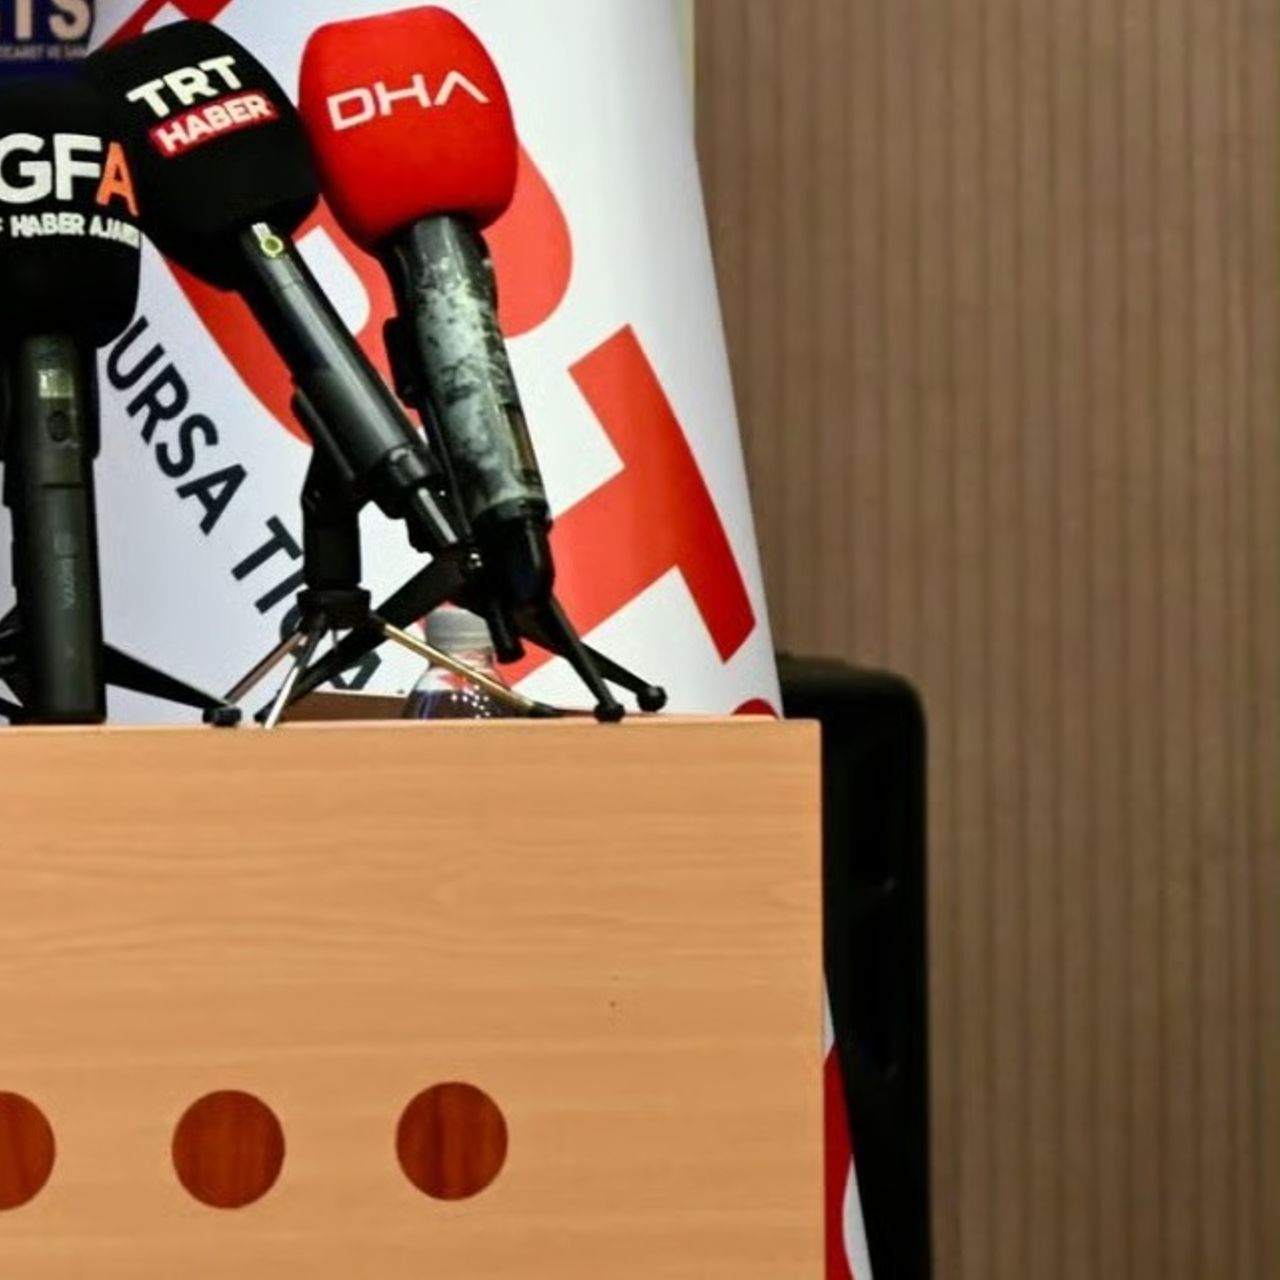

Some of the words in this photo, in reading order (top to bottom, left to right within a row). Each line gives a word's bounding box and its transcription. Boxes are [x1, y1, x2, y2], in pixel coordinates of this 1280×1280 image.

[126, 54, 243, 119] TRT
[326, 69, 490, 132] DHA
[152, 93, 274, 153] HABER
[10, 211, 85, 238] HABER
[105, 314, 248, 536] URSA
